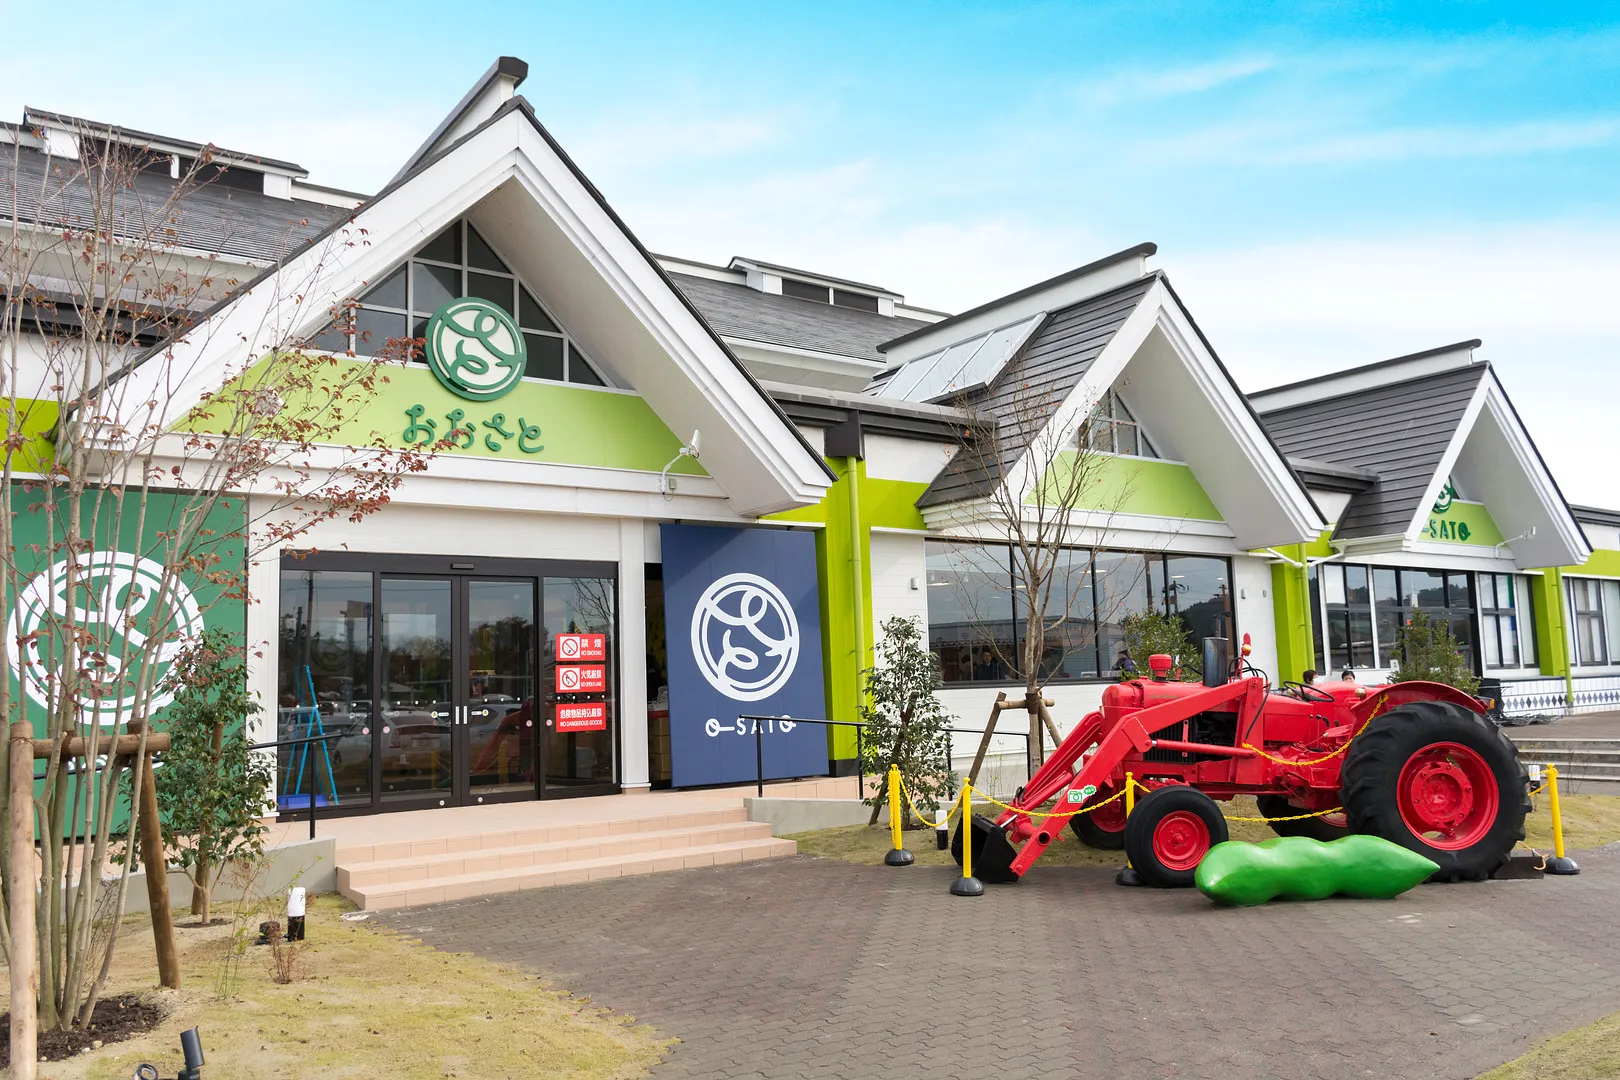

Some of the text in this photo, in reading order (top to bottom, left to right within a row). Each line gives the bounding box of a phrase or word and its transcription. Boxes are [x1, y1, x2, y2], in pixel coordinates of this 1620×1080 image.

[403, 404, 545, 453] おおさと
[1421, 519, 1471, 541] -SATO
[581, 669, 602, 679] 火気厳禁
